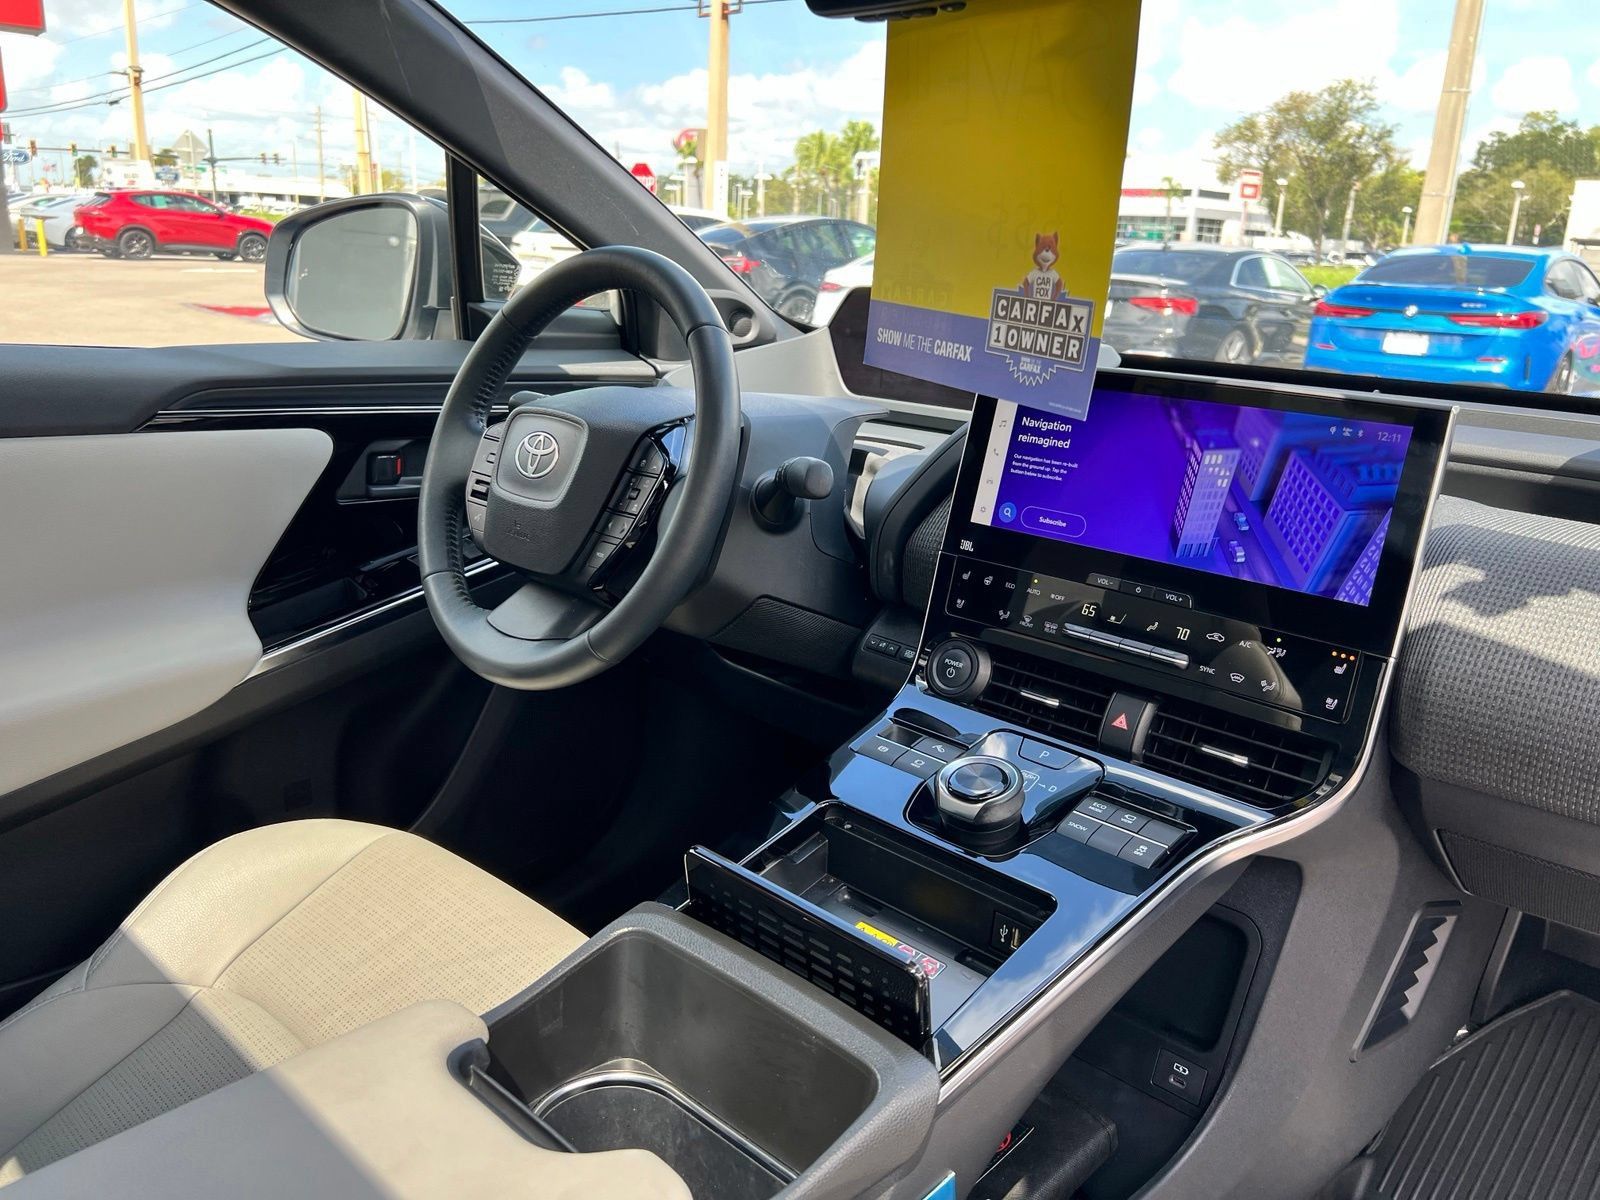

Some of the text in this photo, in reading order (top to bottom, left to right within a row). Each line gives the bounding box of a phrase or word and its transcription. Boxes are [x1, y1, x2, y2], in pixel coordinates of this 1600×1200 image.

[1035, 276, 1052, 288] CAR
[1034, 287, 1051, 298] FOX
[996, 298, 1086, 334] CARFAX
[876, 326, 974, 363] SHOW ME THE CARFAX
[993, 325, 1082, 359] 1 OWNER
[1021, 416, 1072, 432] Navigation
[1018, 433, 1071, 448] reimagined
[1377, 431, 1401, 443] 12:11
[1022, 455, 1043, 463] navigation
[1039, 516, 1067, 528] Subscribe
[960, 540, 973, 551] JBL
[1005, 581, 1016, 590] ECO
[1026, 587, 1041, 596] AUTO
[1081, 603, 1097, 617] 65
[1175, 626, 1191, 642] 70
[1239, 639, 1253, 650] A/C
[944, 657, 964, 669] POWER
[1199, 664, 1216, 676] SYNC
[1039, 750, 1050, 758] P
[1048, 785, 1058, 793] D
[1092, 802, 1107, 810] ECO
[1068, 821, 1088, 831] SNOW
